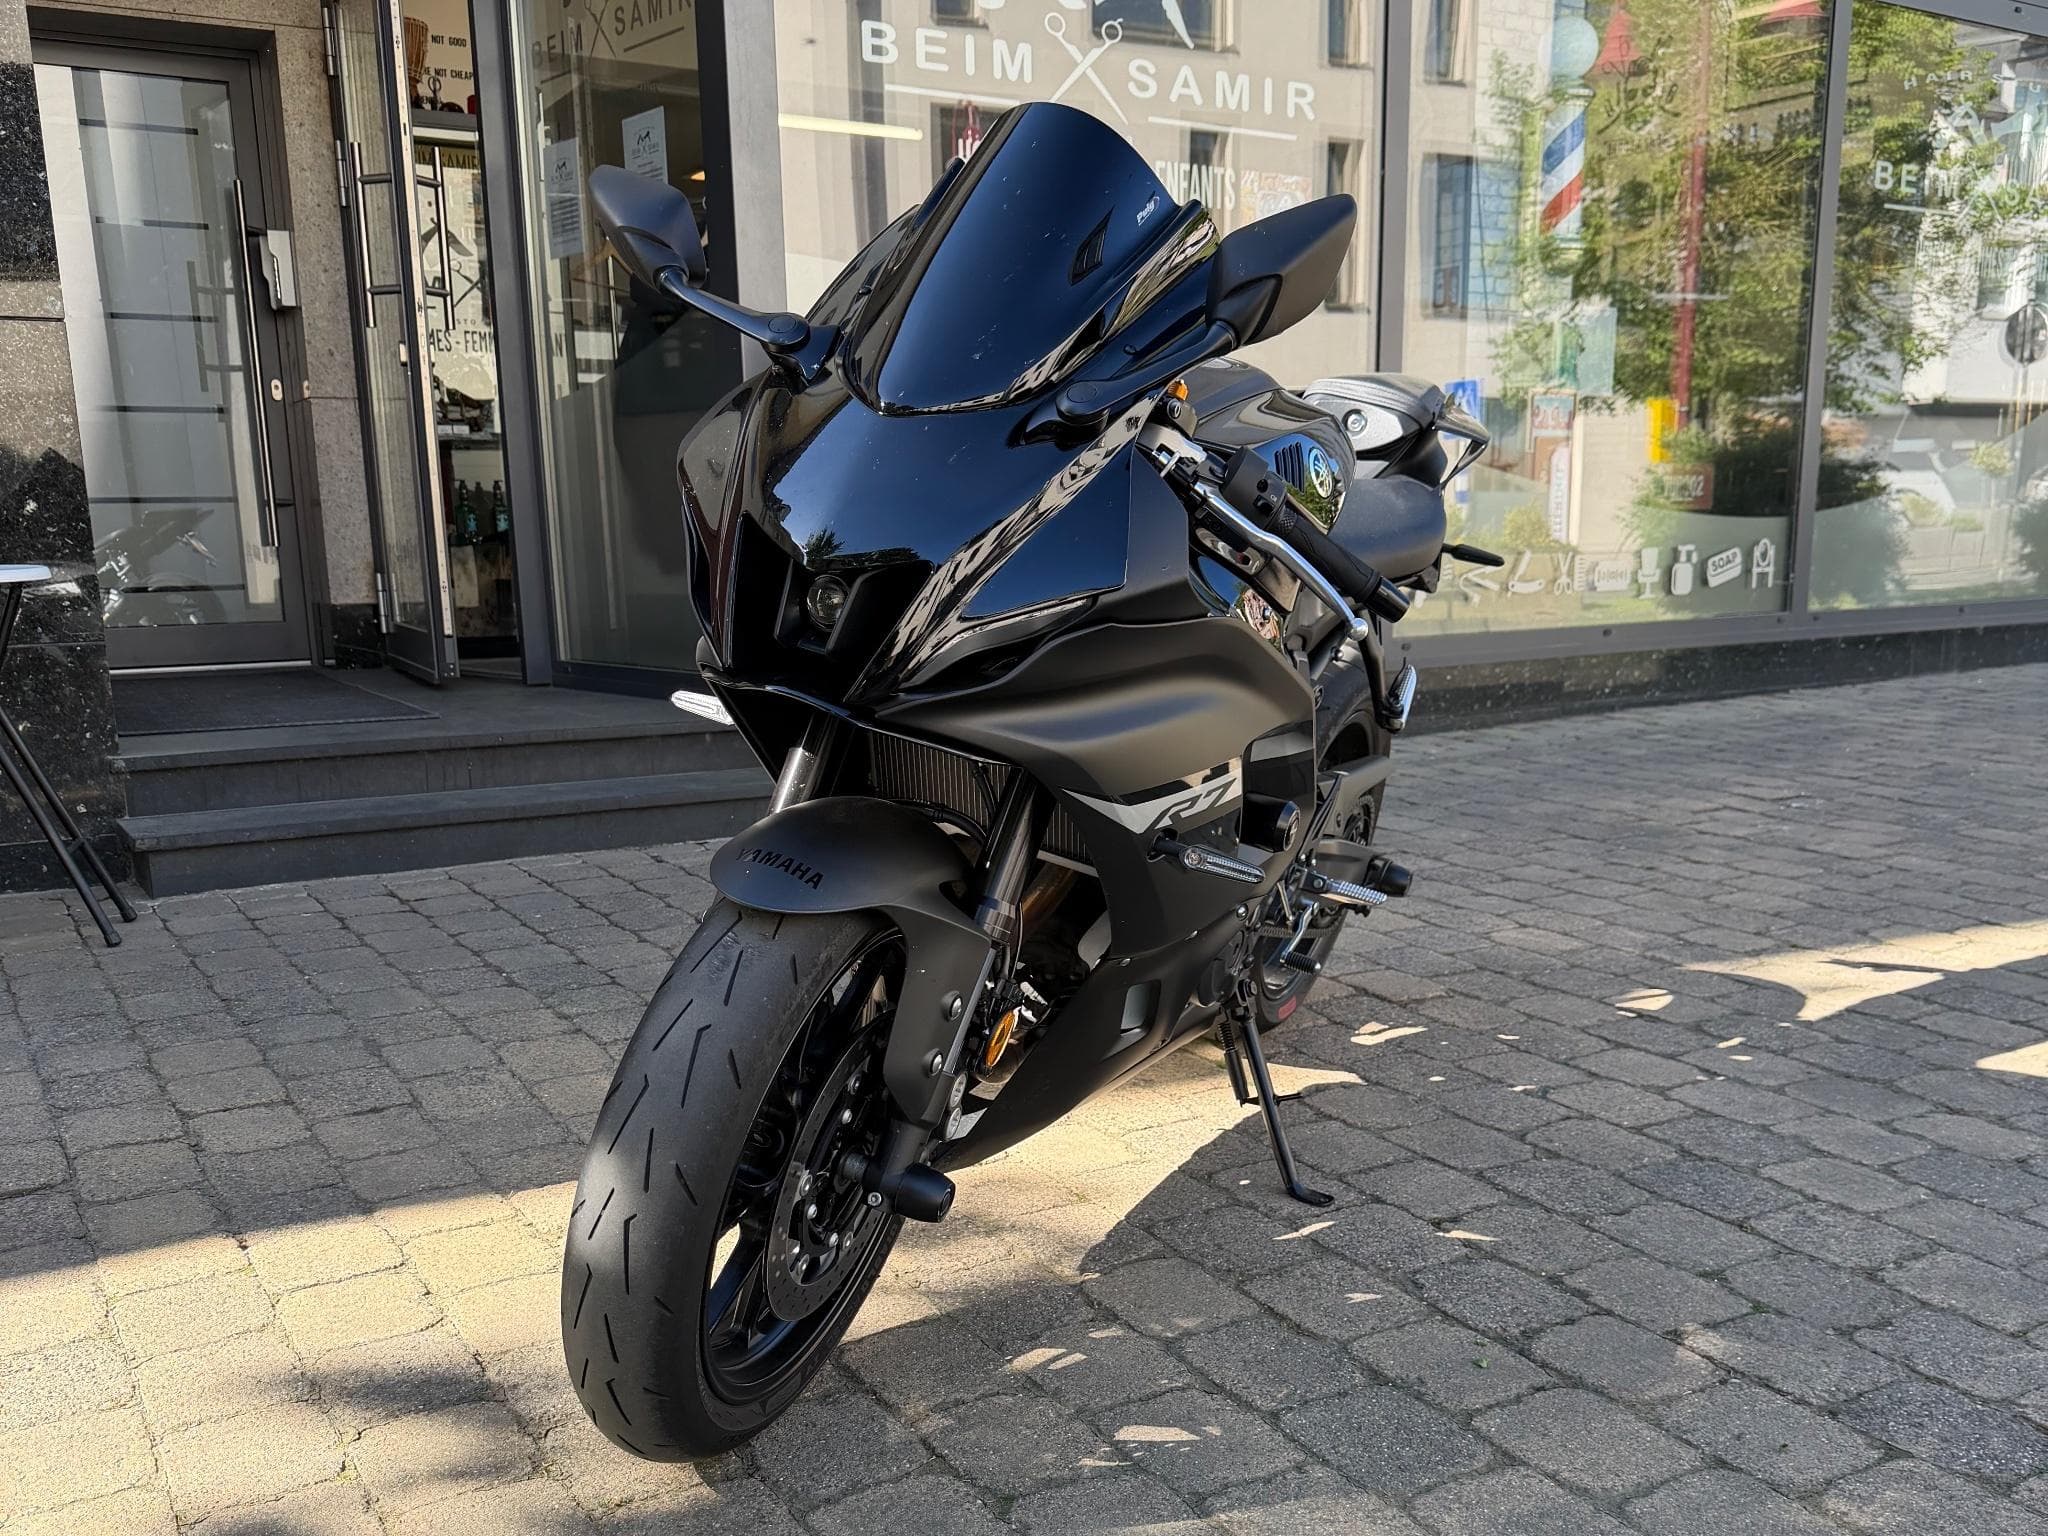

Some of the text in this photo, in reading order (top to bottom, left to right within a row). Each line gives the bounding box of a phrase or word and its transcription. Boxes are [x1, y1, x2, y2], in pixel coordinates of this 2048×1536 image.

[431, 34, 467, 48] NOT GOOD
[531, 23, 584, 69] BEIM
[434, 68, 447, 78] NOT
[450, 69, 473, 81] CHEAP
[861, 19, 1316, 120] BEIM SAMIR
[1903, 70, 1973, 91] HAIR
[1136, 199, 1156, 223] Puig
[1711, 551, 1738, 572] SOAP
[736, 848, 824, 890] YAMAHA
